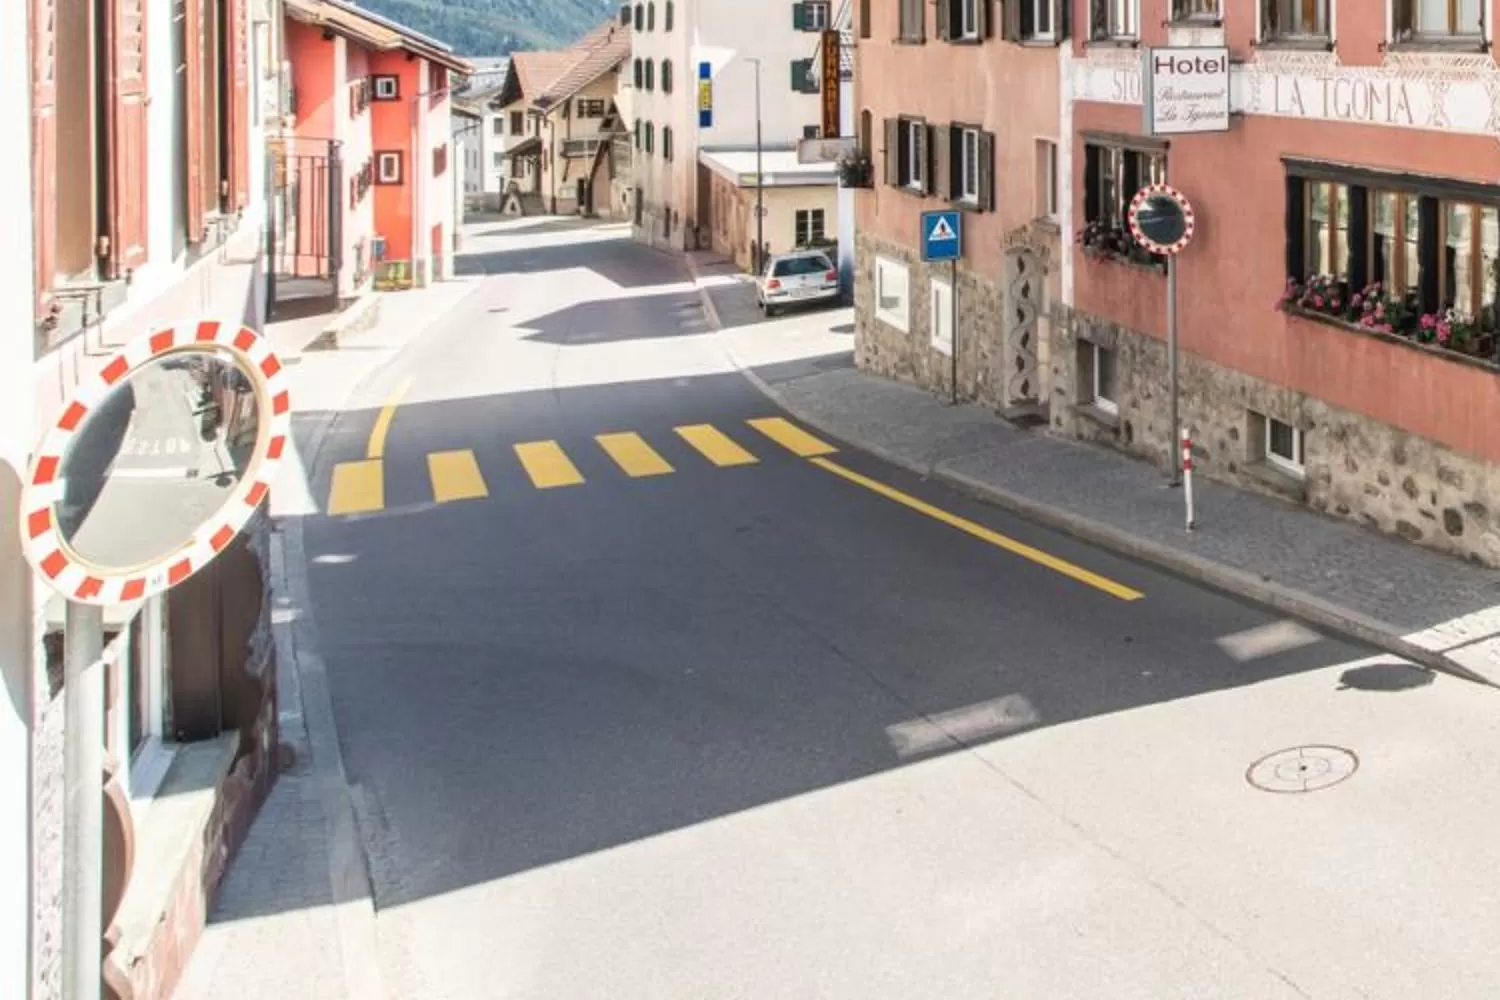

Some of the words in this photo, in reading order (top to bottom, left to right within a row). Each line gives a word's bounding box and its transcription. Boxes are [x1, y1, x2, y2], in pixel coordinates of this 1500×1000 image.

[1154, 55, 1226, 75] Hotel
[1274, 74, 1305, 116] LA
[1314, 77, 1414, 125] TGOMA
